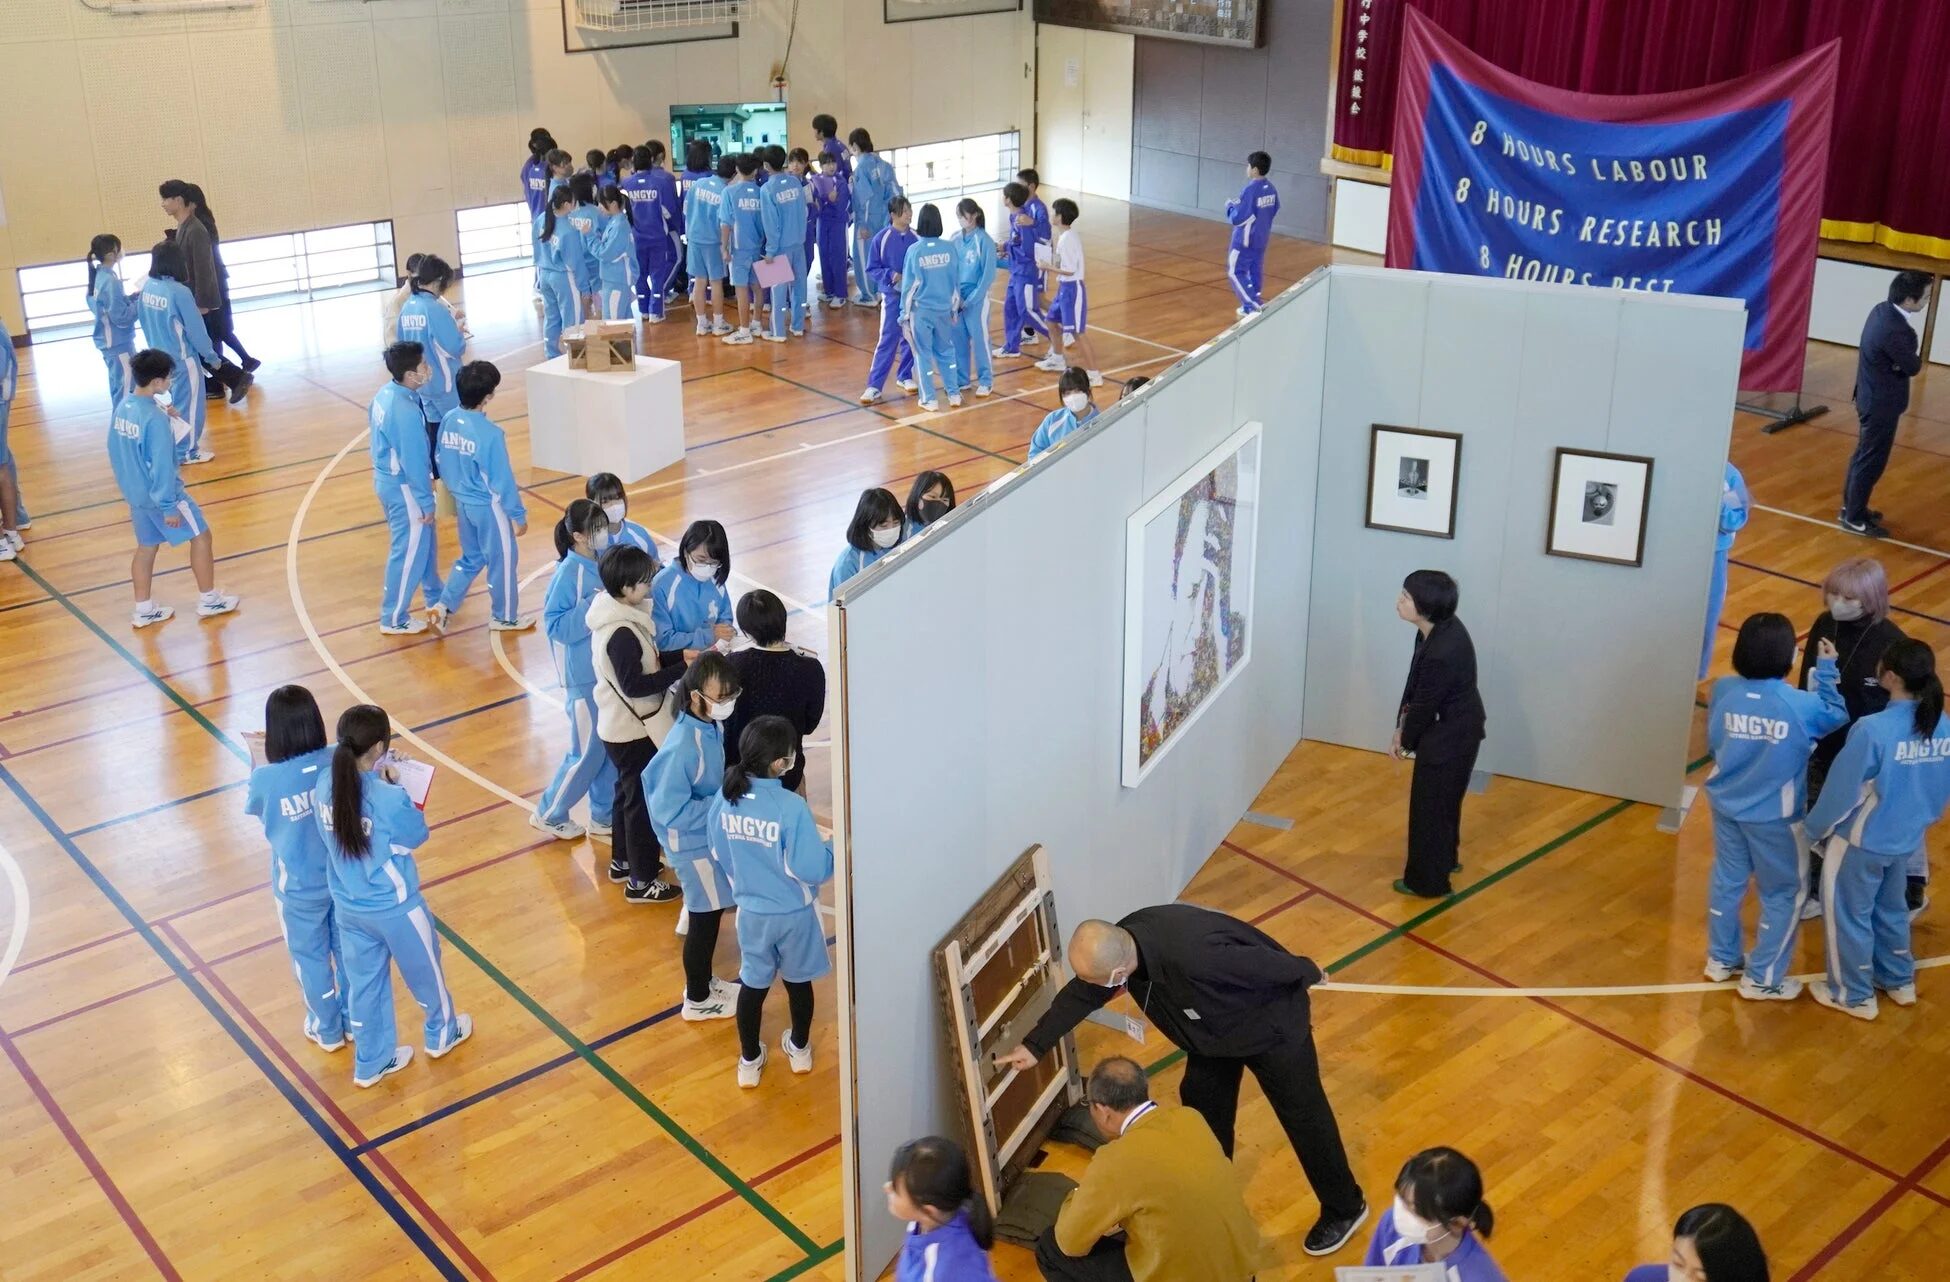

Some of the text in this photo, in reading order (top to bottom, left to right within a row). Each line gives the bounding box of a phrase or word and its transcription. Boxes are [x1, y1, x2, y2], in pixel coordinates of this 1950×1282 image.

[1470, 120, 1708, 182] 8 HOURS LABOUR
[1455, 177, 1721, 247] 8 HOURS RESEARCH
[919, 252, 950, 267] ANGYO
[1480, 244, 1490, 269] 8
[1725, 712, 1789, 739] ANGYO
